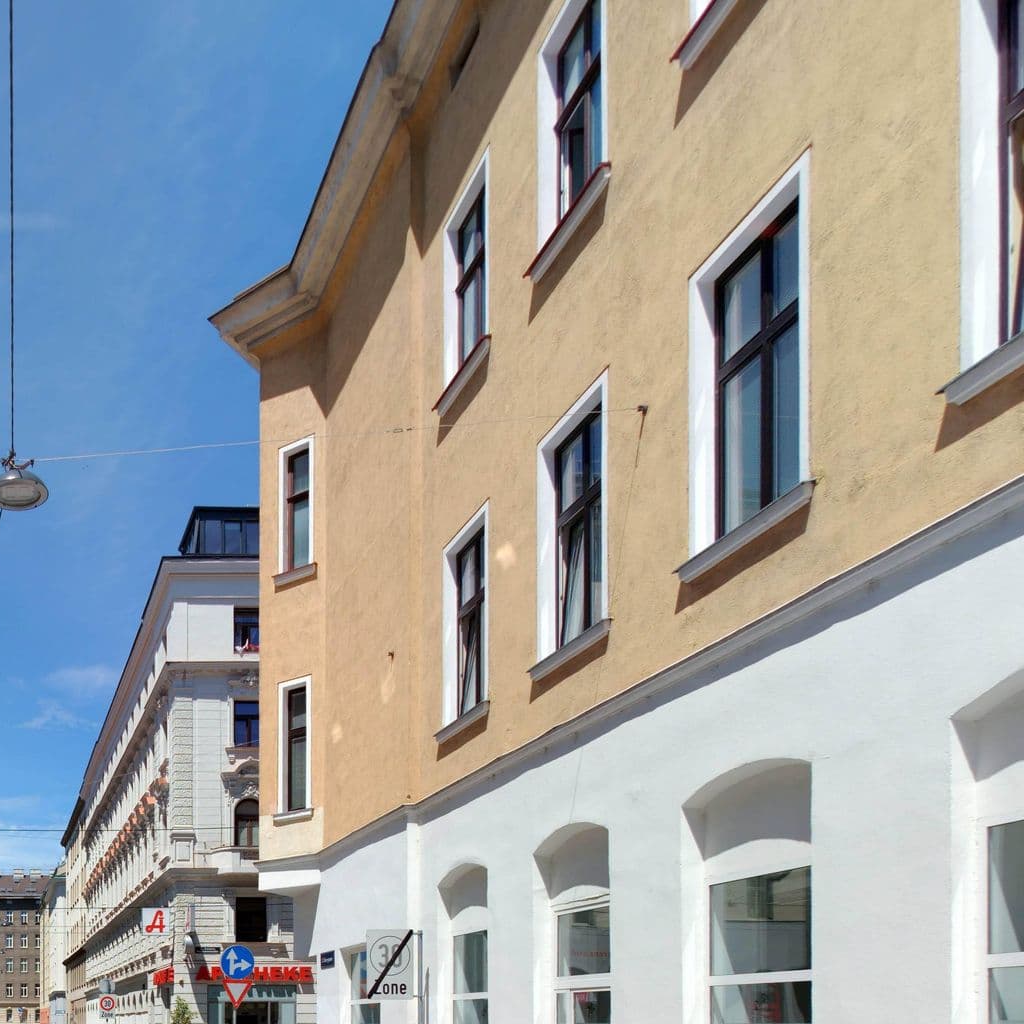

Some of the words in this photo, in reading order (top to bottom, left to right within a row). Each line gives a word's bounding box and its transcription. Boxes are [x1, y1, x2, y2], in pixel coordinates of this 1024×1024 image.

[378, 943, 402, 967] 30
[196, 966, 313, 980] APHEKE
[103, 999, 112, 1008] 30
